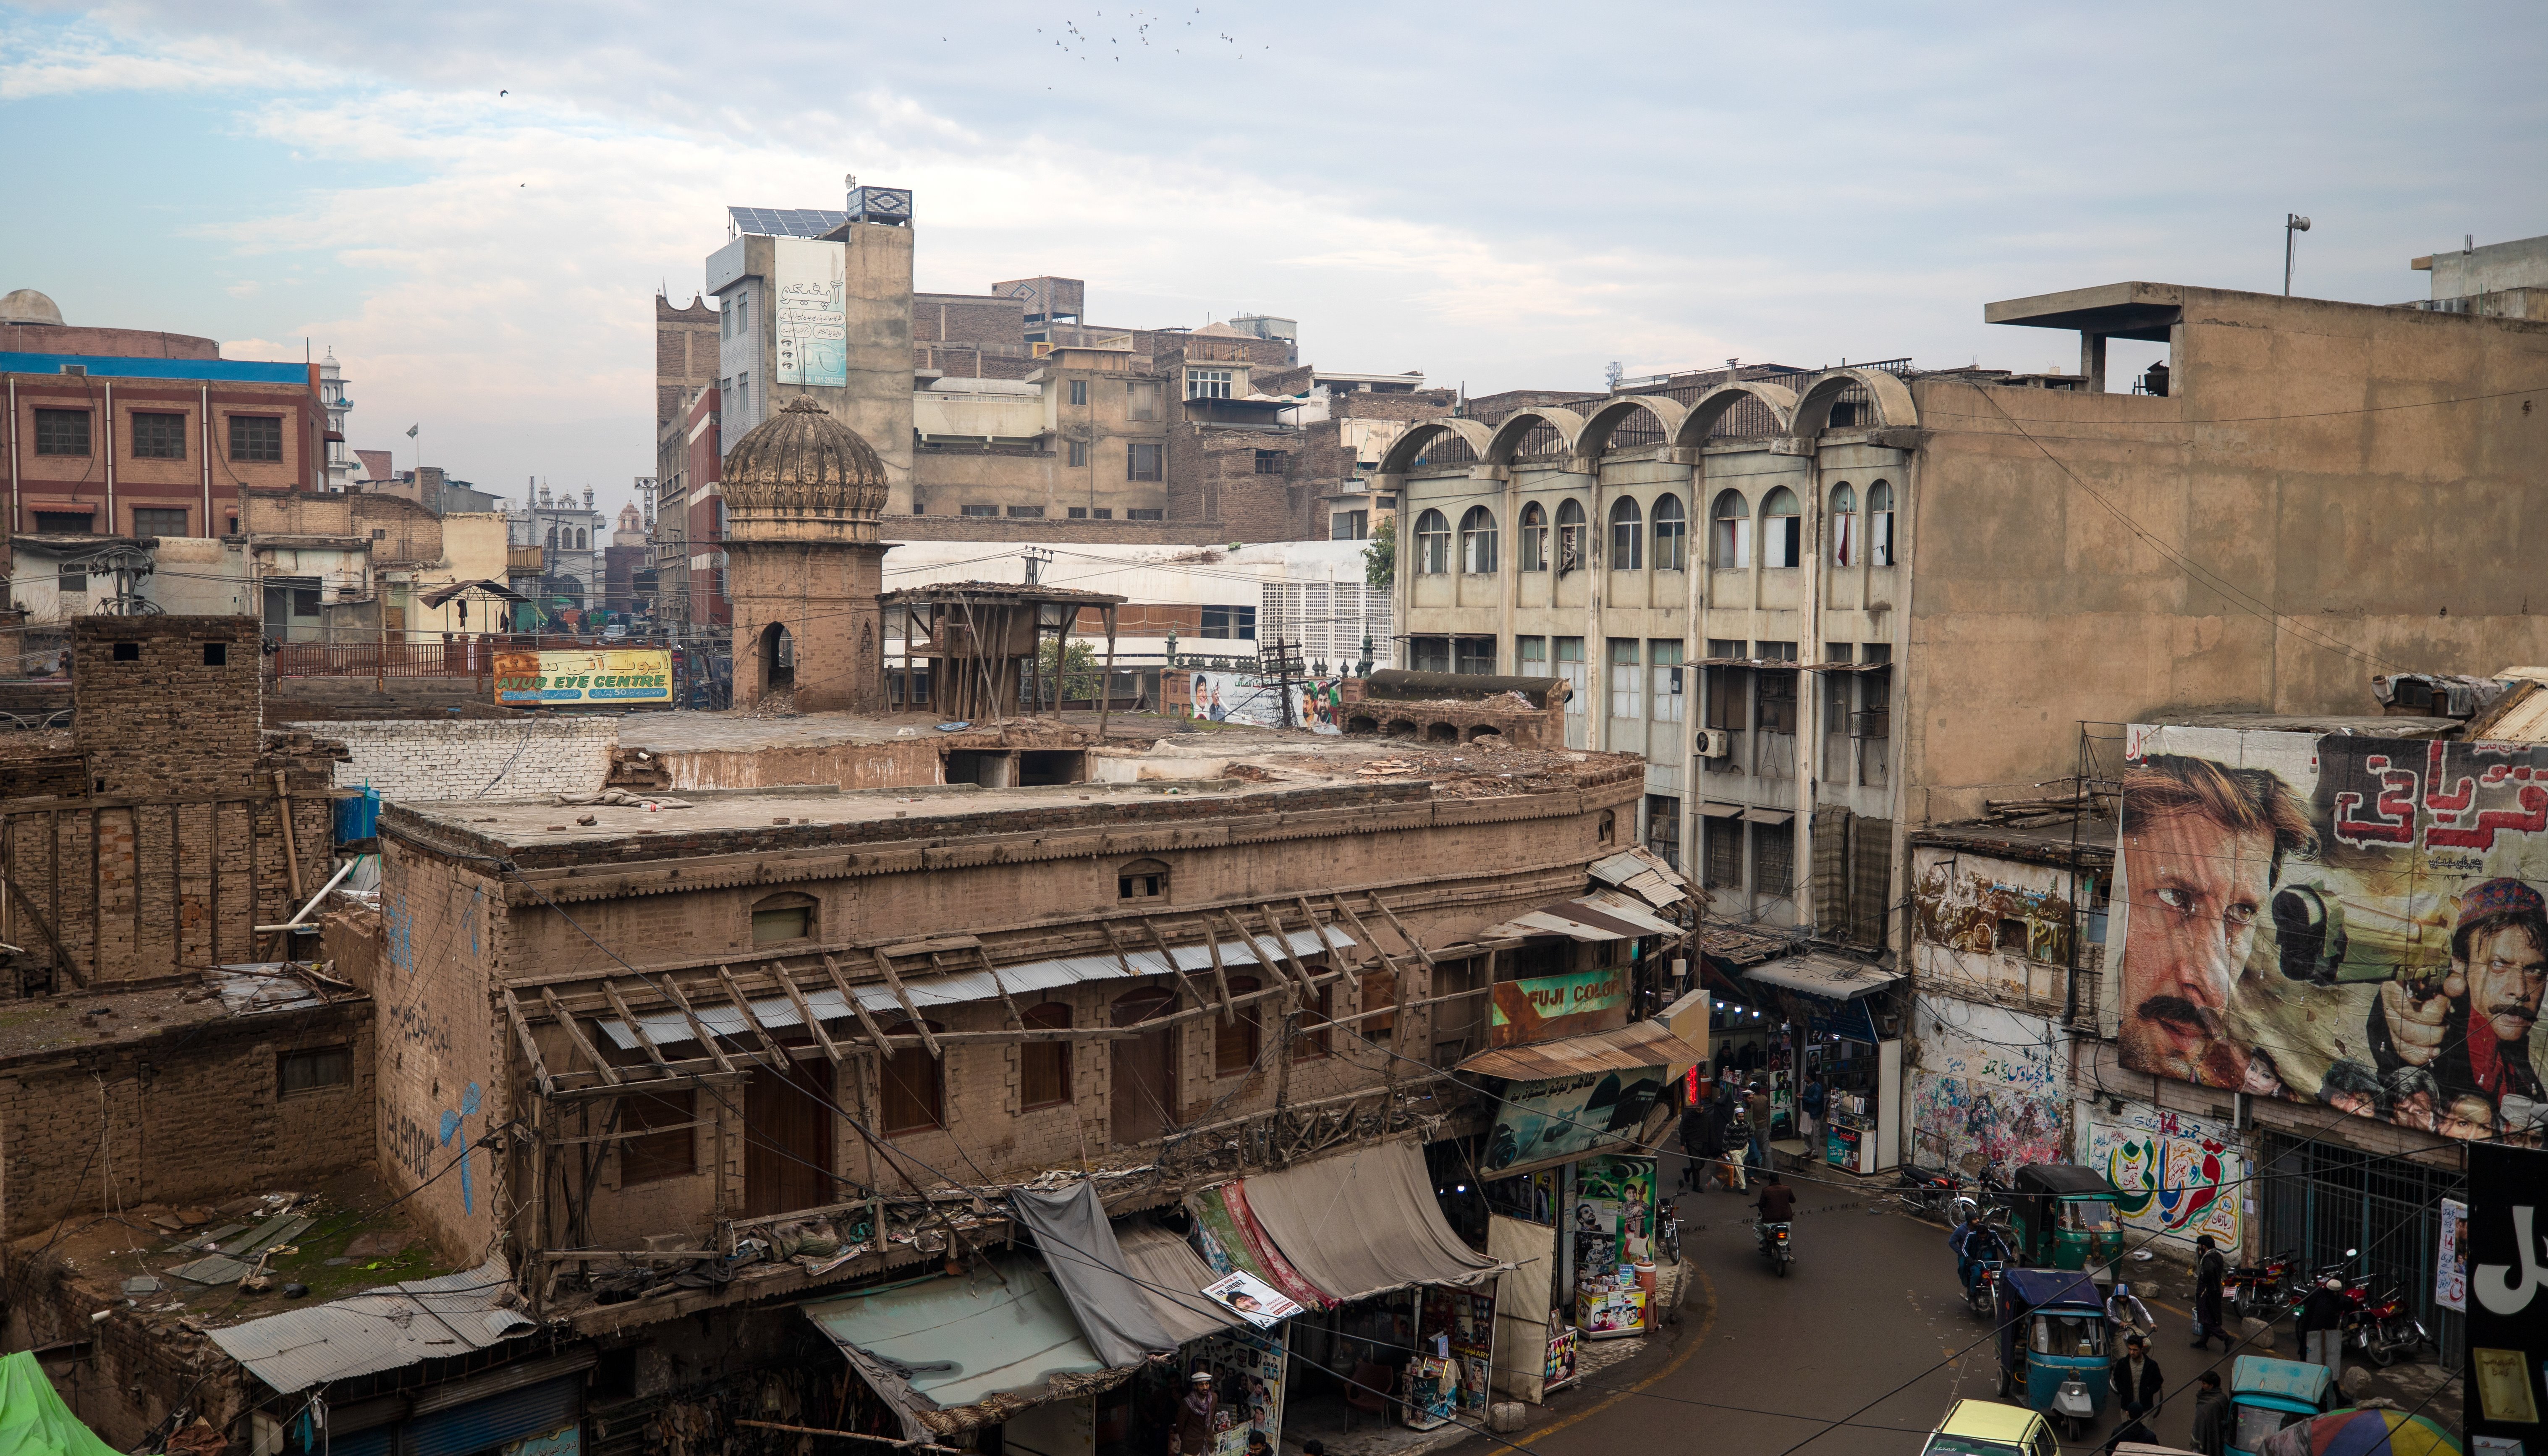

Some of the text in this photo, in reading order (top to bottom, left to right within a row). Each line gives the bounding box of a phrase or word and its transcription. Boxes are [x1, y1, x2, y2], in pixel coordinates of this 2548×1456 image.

[780, 281, 843, 310] آپٹیکو
[814, 376, 845, 385] 091-2563322
[565, 653, 606, 675] آئی
[608, 657, 669, 674] ایوب
[498, 675, 666, 689] AYUB EYE CENTRE
[2455, 855, 2470, 869] رنگین
[2469, 858, 2483, 873] پشتو
[1528, 980, 1621, 1006] FUJI COLOR
[2158, 1113, 2179, 1136] 14
[1838, 1132, 1856, 1142] خیبر
[2445, 1234, 2454, 1249] 14
[1214, 1279, 1246, 1297] Zubair Ali
[1265, 1295, 1284, 1307] TOGETHER
[1269, 1299, 1288, 1310] PESHAWAR
[1476, 1350, 1490, 1359] ARY
[1413, 1380, 1427, 1390] ARY
